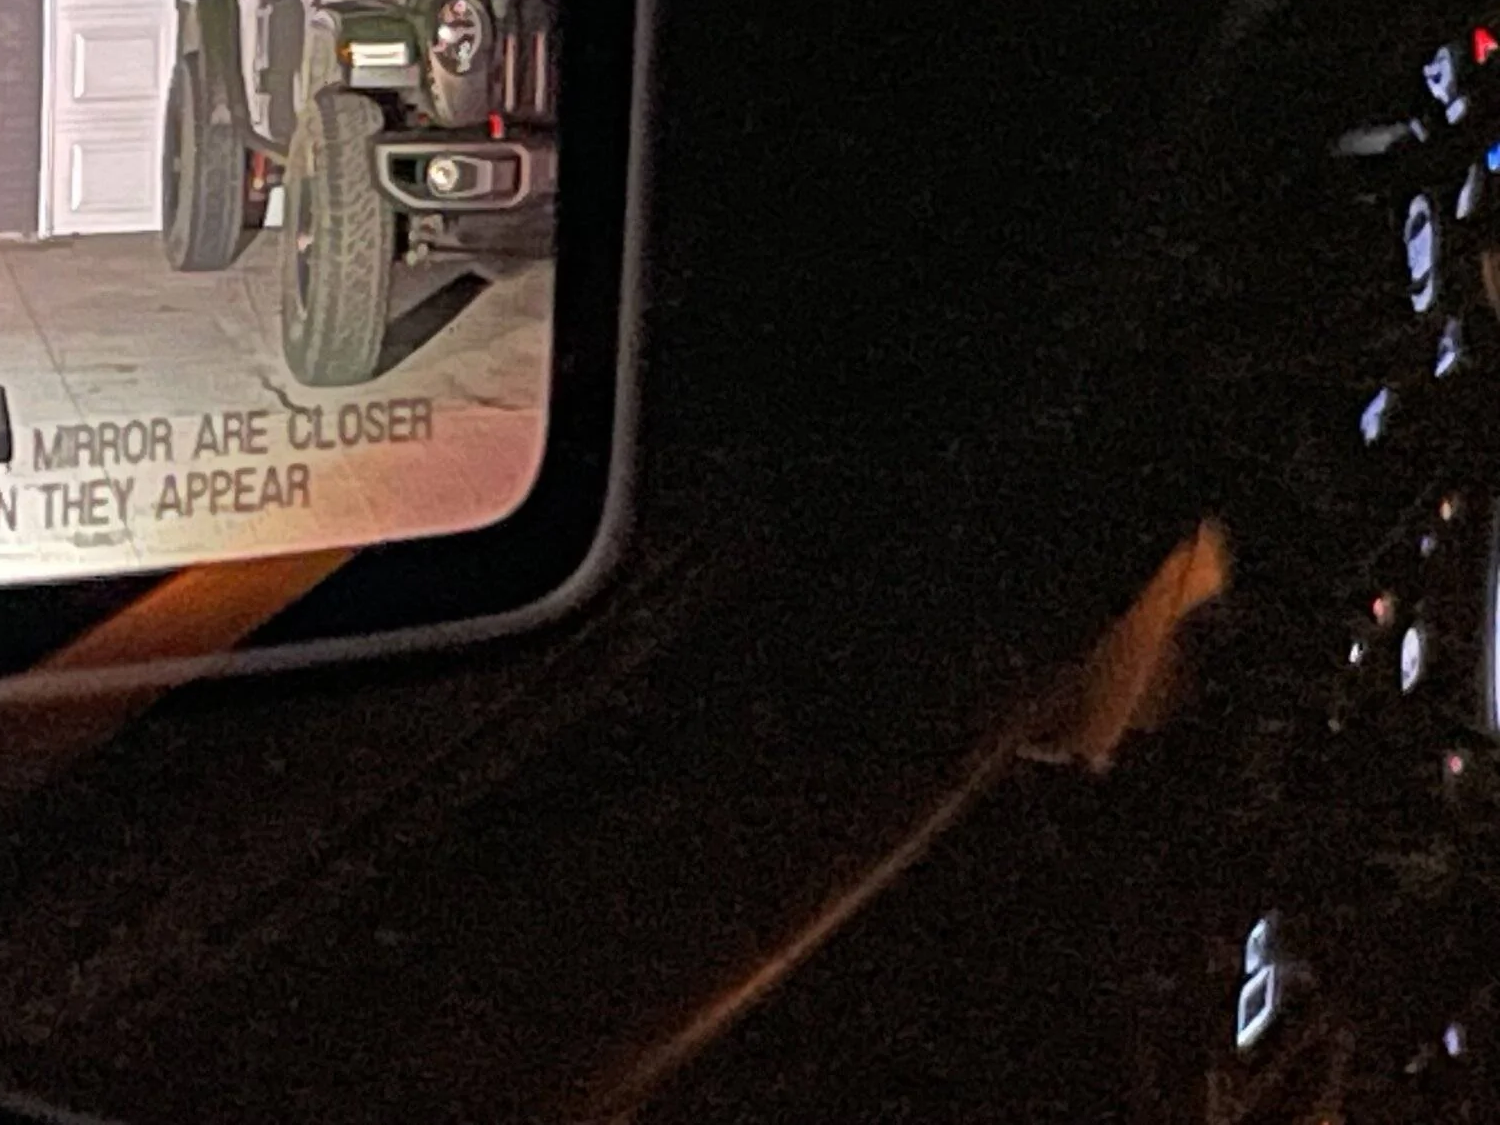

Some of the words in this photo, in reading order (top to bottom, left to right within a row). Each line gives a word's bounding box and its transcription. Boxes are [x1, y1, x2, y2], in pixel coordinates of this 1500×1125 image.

[192, 409, 269, 460] ARE
[288, 397, 433, 450] CLOSER
[40, 476, 134, 529] THEY
[156, 463, 311, 520] APPEAR
